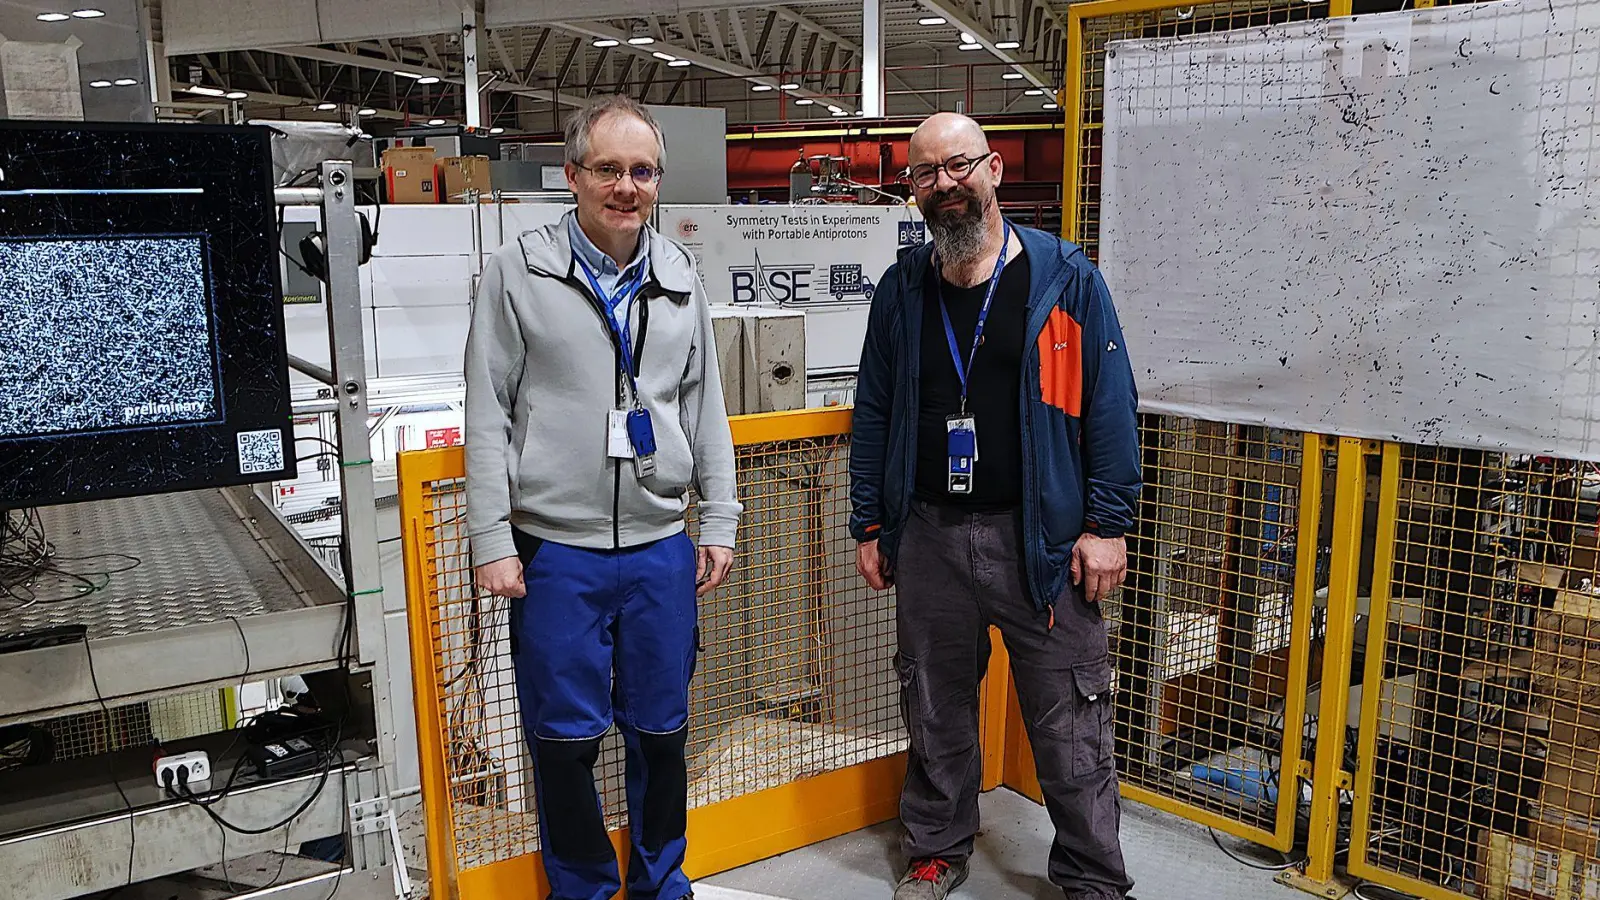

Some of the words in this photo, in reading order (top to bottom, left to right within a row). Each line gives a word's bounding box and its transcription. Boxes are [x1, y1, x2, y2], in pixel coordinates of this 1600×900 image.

[684, 224, 699, 232] erc
[726, 215, 779, 228] Symmetry
[781, 215, 808, 226] Tests
[810, 215, 820, 225] in
[822, 215, 880, 228] Experiments
[742, 229, 765, 240] with
[767, 229, 810, 240] Portable
[812, 228, 868, 241] Antiprotons
[732, 250, 811, 303] BASE
[124, 400, 205, 422] preliminary
